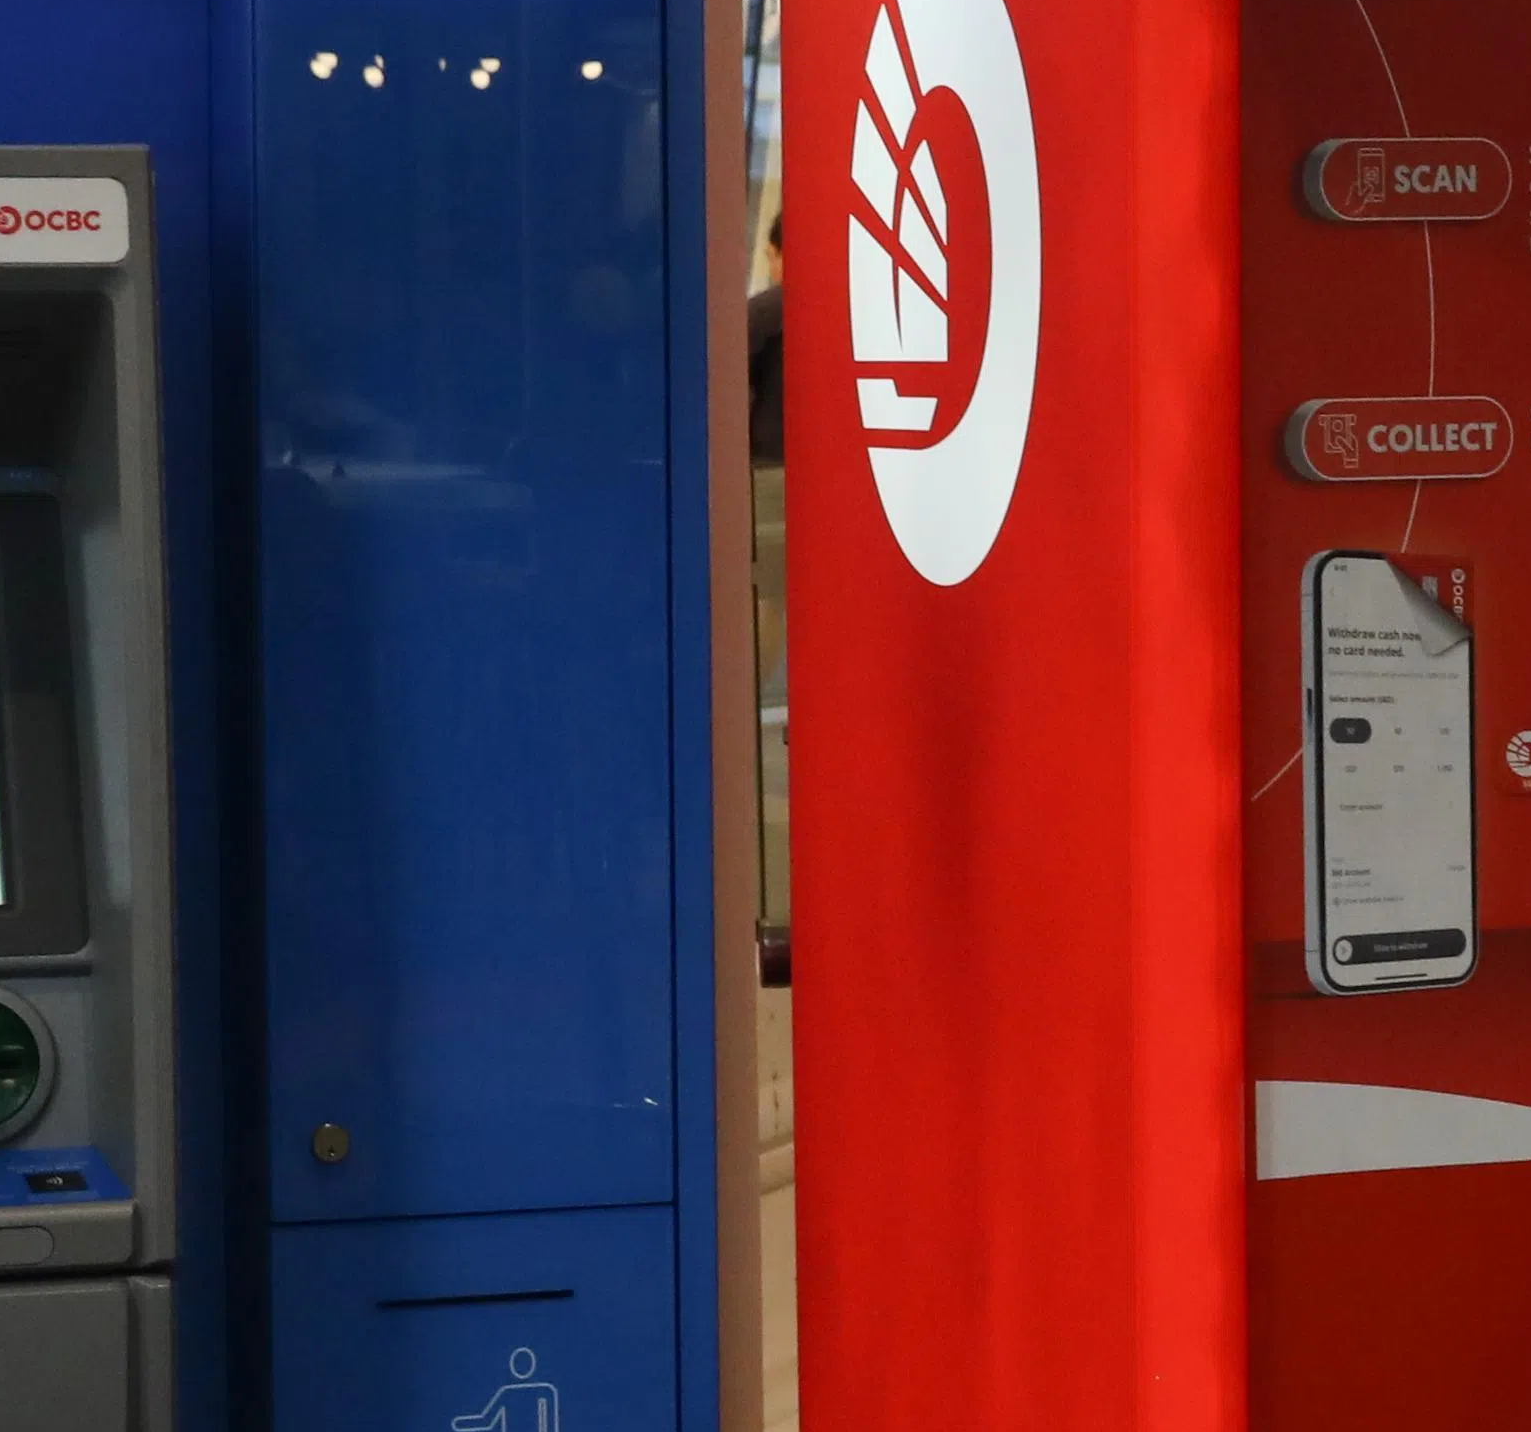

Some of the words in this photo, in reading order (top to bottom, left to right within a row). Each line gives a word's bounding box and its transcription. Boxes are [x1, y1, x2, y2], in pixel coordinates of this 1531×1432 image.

[1394, 164, 1478, 194] SCAN
[25, 210, 101, 232] OCBC
[1368, 421, 1497, 454] COLLECT
[1378, 629, 1400, 641] cash
